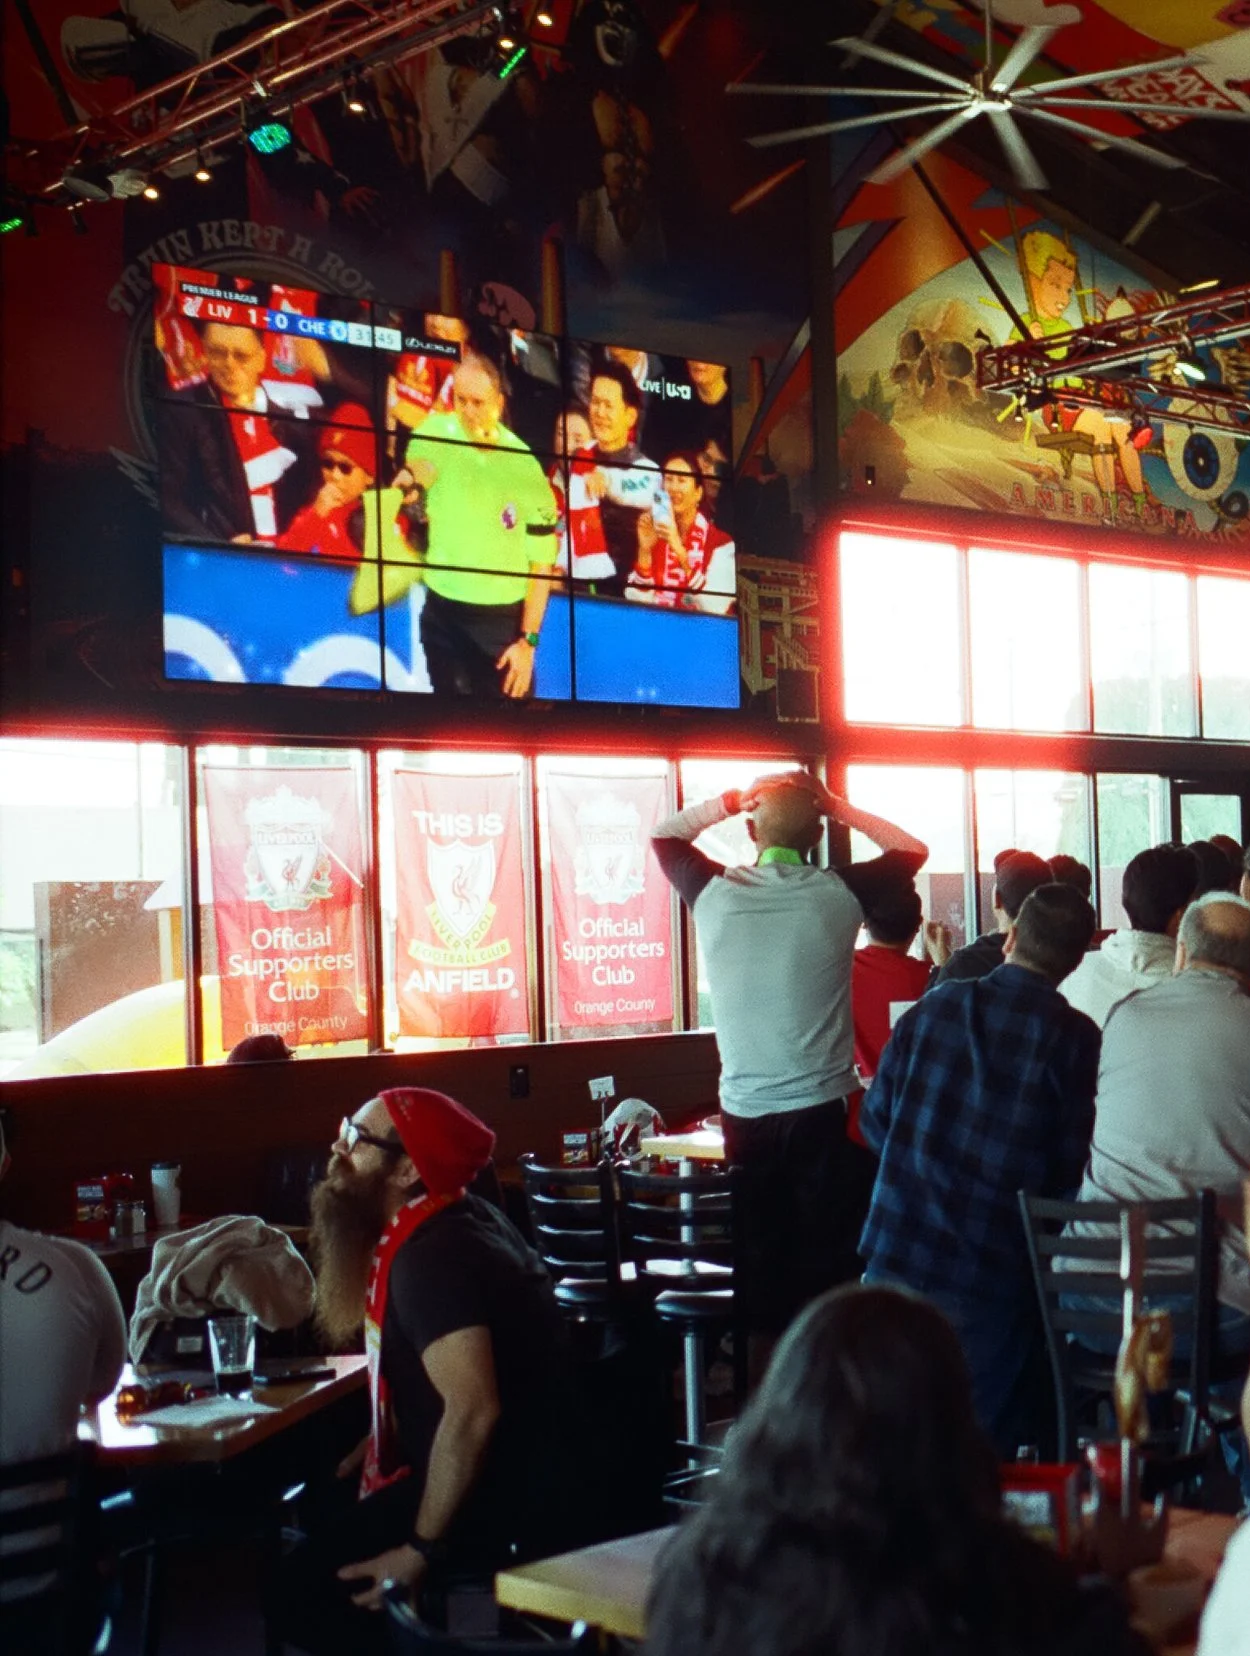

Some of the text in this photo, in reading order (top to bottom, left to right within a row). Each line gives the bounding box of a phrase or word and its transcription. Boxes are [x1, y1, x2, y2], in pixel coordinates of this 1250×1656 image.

[197, 218, 285, 252] KEPT
[181, 283, 259, 305] PREMIER LEAGUE
[207, 303, 233, 320] LIV
[297, 318, 326, 336] CHE
[412, 810, 505, 837] THIS IS
[251, 925, 333, 950] Official
[430, 908, 493, 951] LIVERPOOL
[579, 917, 645, 938] Official
[480, 943, 508, 961] CLUB
[562, 940, 665, 965] Supporters
[228, 952, 355, 980] Supporters
[591, 965, 636, 986] Club
[268, 981, 320, 1002] Club
[403, 967, 516, 994] ANFIELD
[574, 998, 656, 1016] Orange County
[244, 1016, 349, 1037] Orange County
